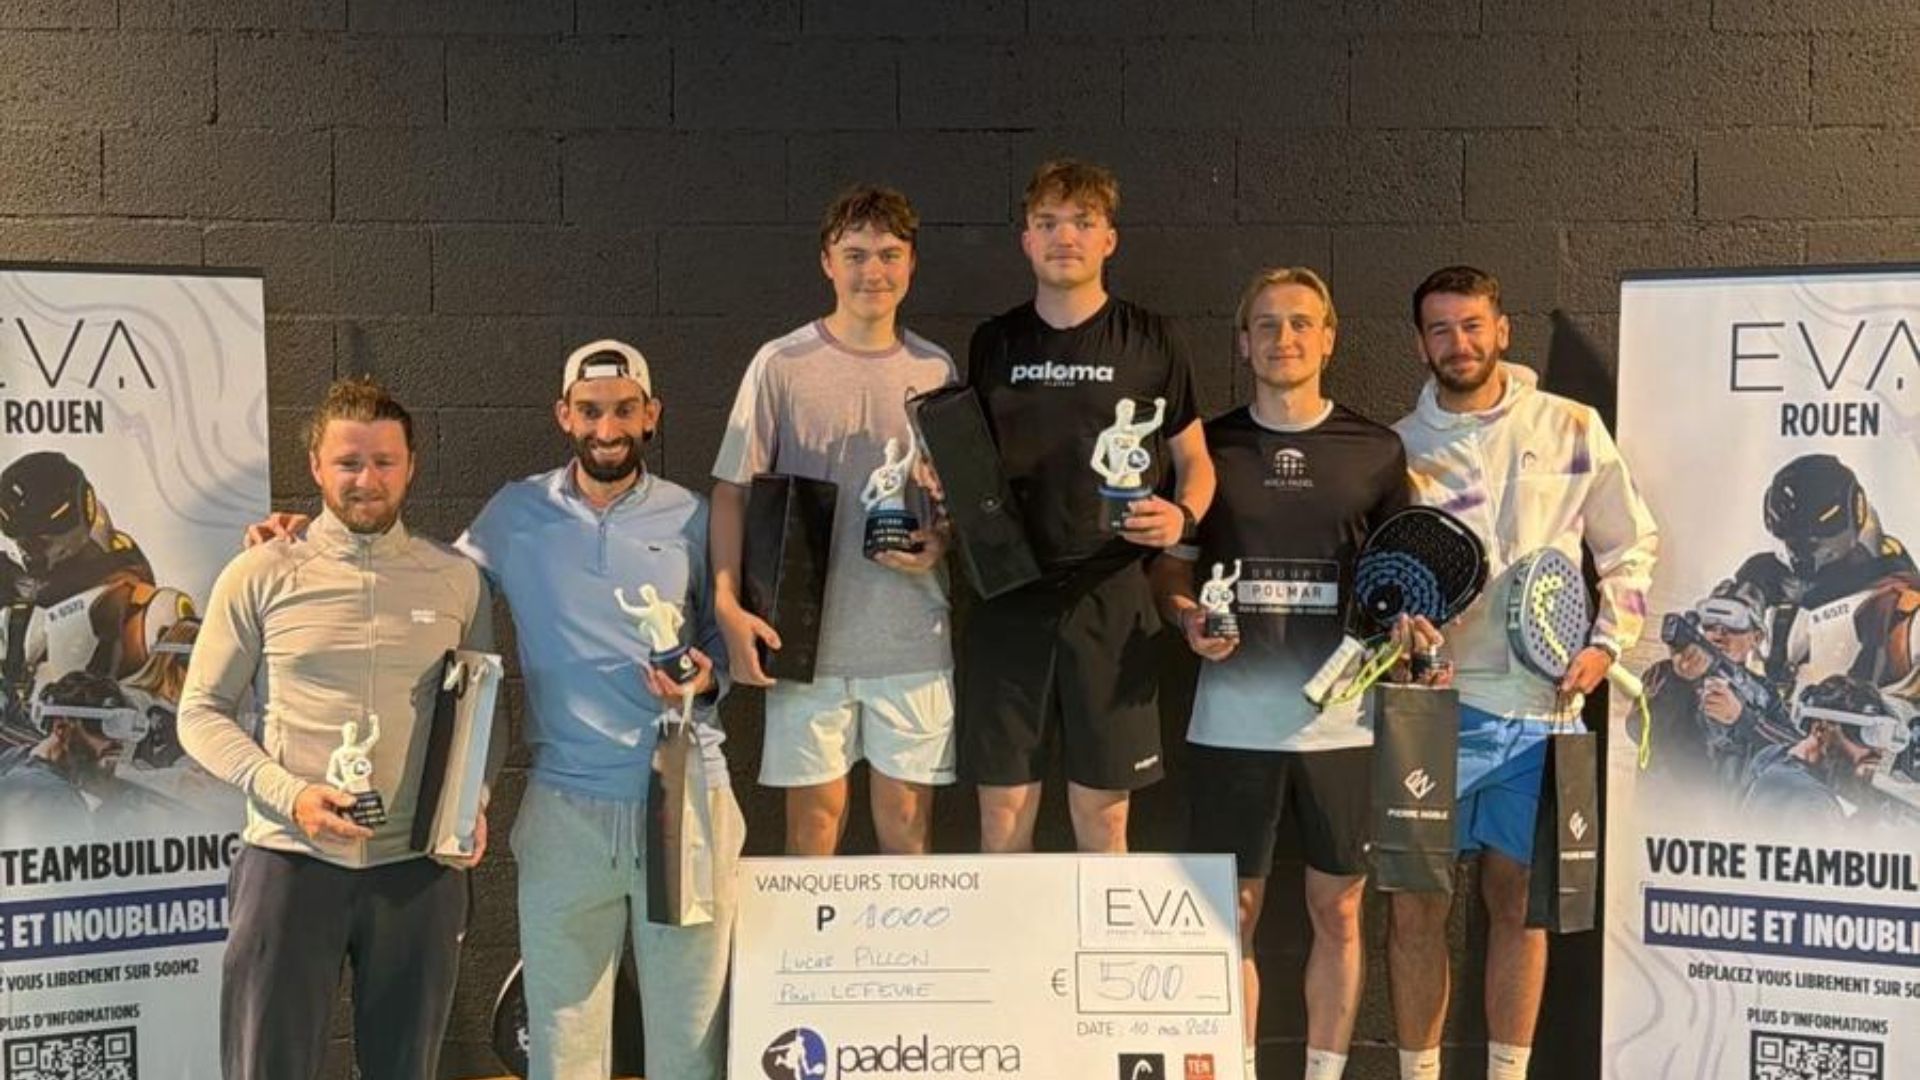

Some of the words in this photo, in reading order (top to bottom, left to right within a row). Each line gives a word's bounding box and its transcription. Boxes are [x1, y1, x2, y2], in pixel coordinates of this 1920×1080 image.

[0, 317, 155, 389] VA
[1730, 319, 1920, 391] EVA
[1011, 360, 1115, 385] paloma
[5, 400, 104, 434] ROUEN
[1781, 402, 1879, 436] ROUEN
[1251, 584, 1323, 599] POLMAR
[1, 832, 240, 887] TEAMBUILDING
[1646, 837, 1746, 878] VOTRE
[1755, 844, 1918, 891] TEAMBUIL
[756, 873, 881, 893] VAINQUEURS
[889, 872, 980, 890] TOURNOI
[816, 904, 835, 932] P
[853, 903, 950, 930] 1000
[1106, 888, 1204, 927] EVA
[12, 912, 45, 949] ET
[1650, 901, 1756, 941] UNIQUE
[1763, 910, 1796, 945] ET
[1803, 913, 1920, 954] INOUBLI
[7, 975, 43, 992] VOUS
[46, 966, 121, 988] LIBREMENT
[124, 963, 151, 979] SUR
[154, 958, 199, 978] 500M2
[831, 982, 935, 999] LEFEVRE
[1051, 968, 1068, 996] €
[1097, 961, 1184, 1001] 500
[1689, 962, 1752, 984] DÉPLACEZ
[1756, 969, 1792, 987] VOUS
[1795, 972, 1869, 993] LIBREMENT
[1873, 979, 1901, 997] SUR
[34, 1003, 140, 1028] D'INFORMATIONS
[1747, 1007, 1778, 1024] PLUS
[1781, 1010, 1888, 1034] D'INFORMATIONS
